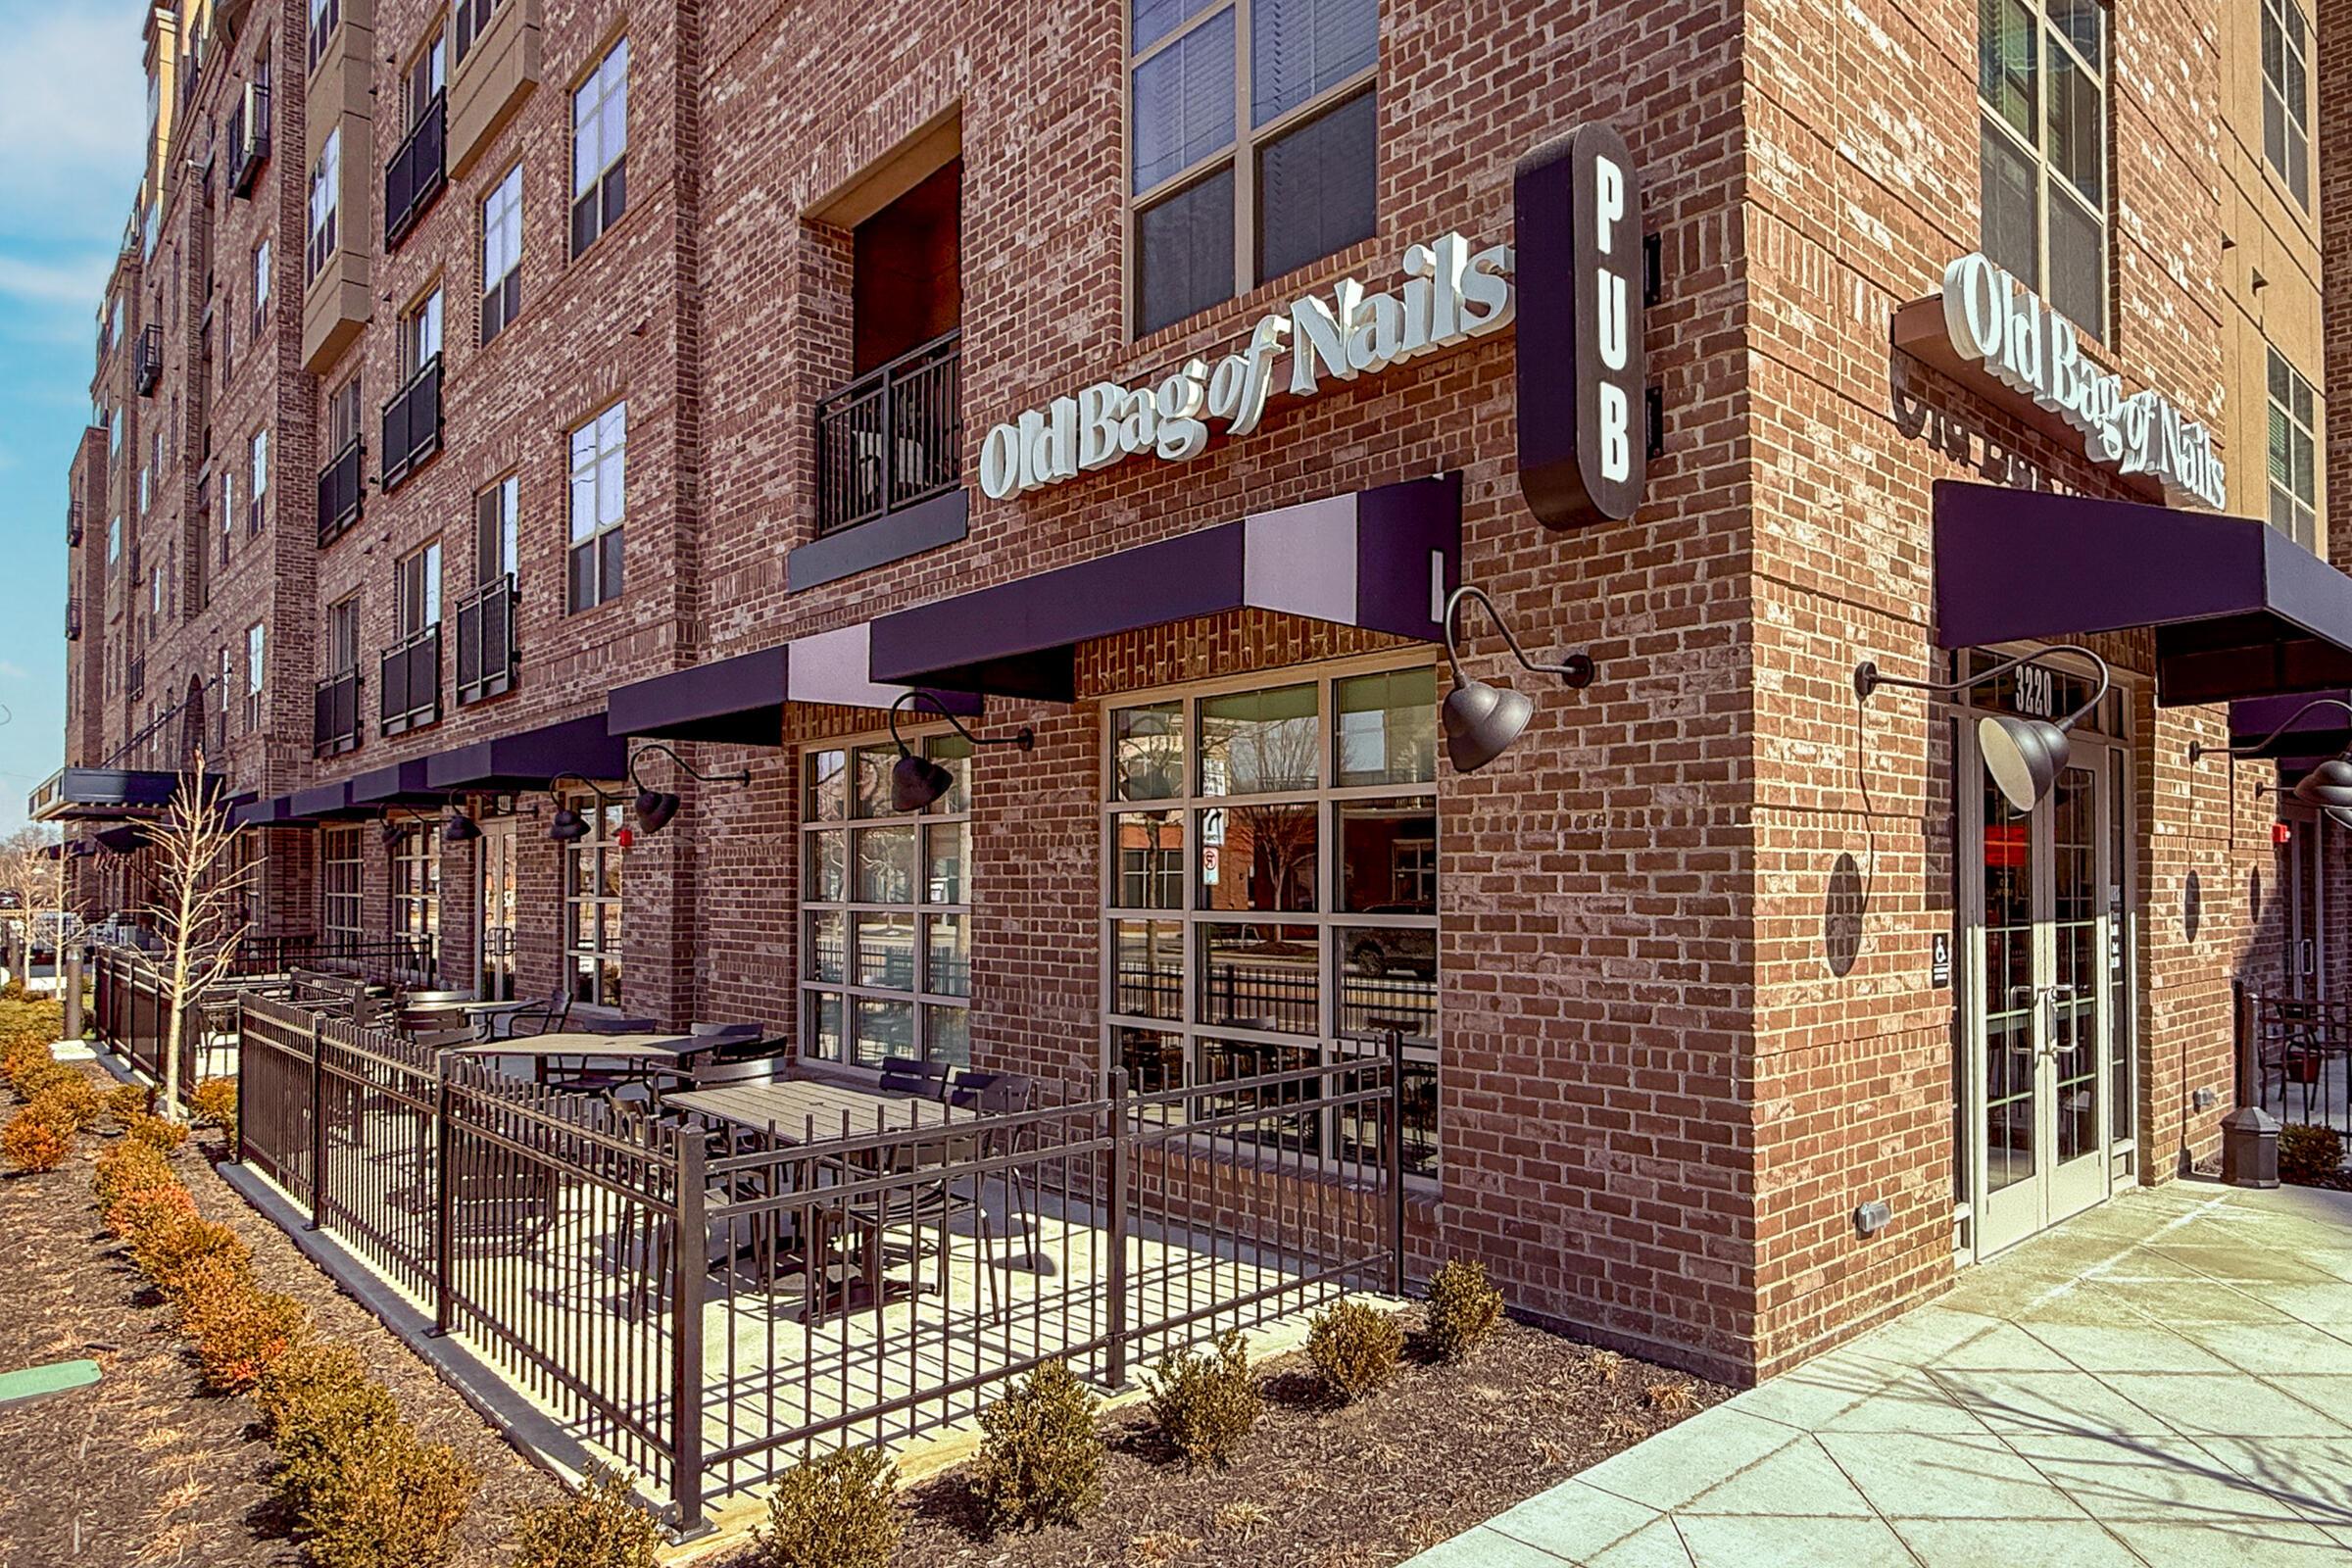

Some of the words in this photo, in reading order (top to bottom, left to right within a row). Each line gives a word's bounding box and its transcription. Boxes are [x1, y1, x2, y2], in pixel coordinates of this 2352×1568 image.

[980, 395, 1077, 500] Old
[1078, 358, 1207, 462] Bag
[1208, 314, 1290, 436] of
[1290, 231, 1515, 394] Nails
[1597, 155, 1629, 483] PUB
[1946, 252, 2044, 392] Old
[2048, 308, 2123, 461] Bag
[2119, 388, 2158, 473] of
[2158, 397, 2226, 511] Nails
[2016, 664, 2052, 717] 3220
